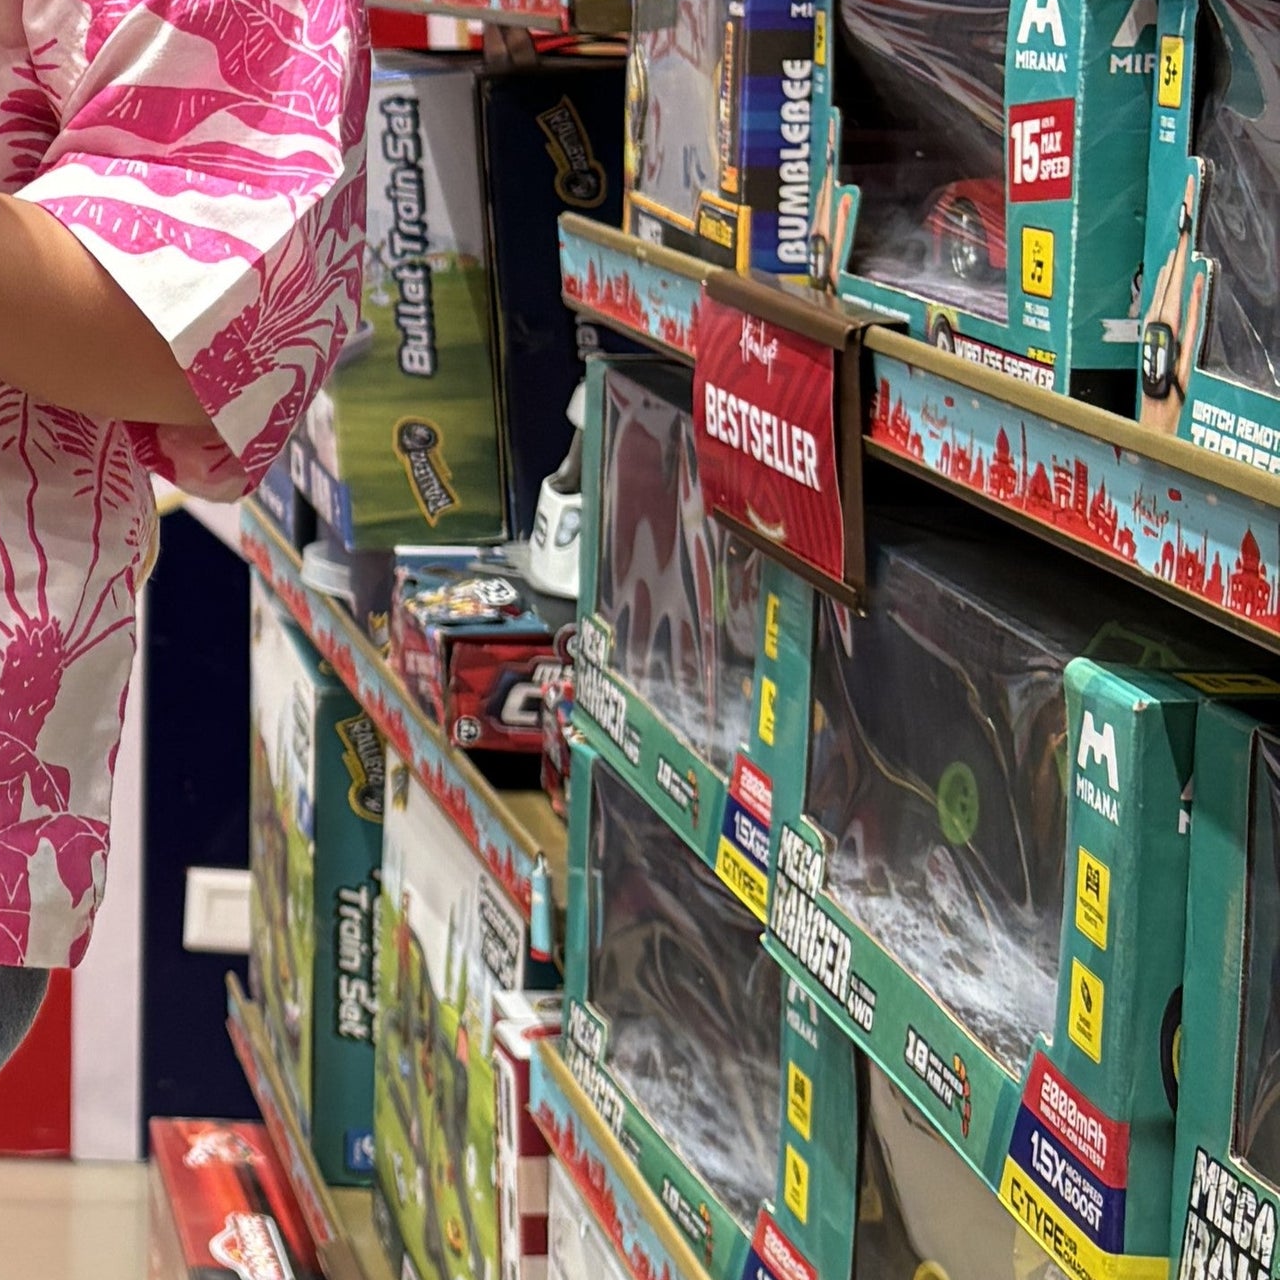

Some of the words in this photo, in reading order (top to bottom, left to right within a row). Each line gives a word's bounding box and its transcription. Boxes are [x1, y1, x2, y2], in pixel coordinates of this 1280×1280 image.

[1015, 50, 1068, 74] MIRANA
[380, 94, 420, 165] Set
[777, 57, 813, 266] BUMBLEBEE
[1009, 118, 1041, 185] 15
[1040, 129, 1062, 156] MAX
[1039, 155, 1071, 181] SPEED
[387, 168, 428, 257] Train
[393, 258, 437, 379] Bullet
[704, 381, 822, 493] BESTSELLER
[1192, 399, 1233, 433] WATCH
[1075, 772, 1121, 826] MIRANA
[778, 824, 823, 896] MEGA
[336, 885, 370, 973] Train
[771, 871, 852, 1009] RANGER
[847, 989, 875, 1033] 4WD
[336, 975, 370, 1042] Set
[1041, 1073, 1107, 1155] 2000mAh
[1031, 1130, 1066, 1189] 1.5X
[1010, 1177, 1065, 1255] C-TYPE
[1064, 1180, 1104, 1232] BOOST
[1192, 1147, 1277, 1271] MEGA
